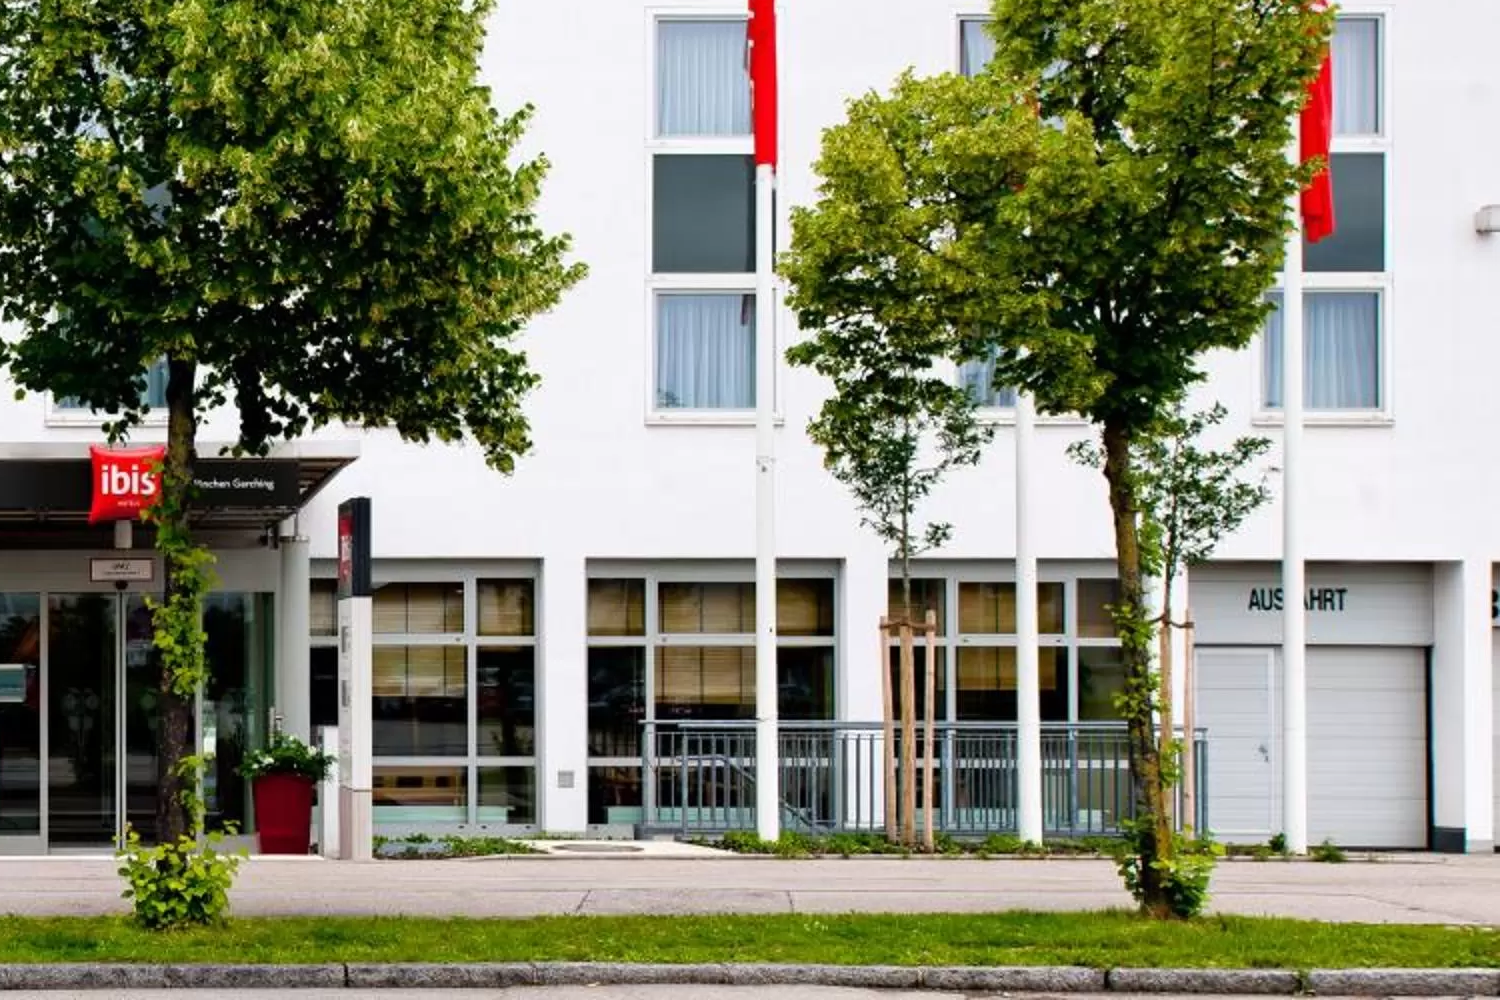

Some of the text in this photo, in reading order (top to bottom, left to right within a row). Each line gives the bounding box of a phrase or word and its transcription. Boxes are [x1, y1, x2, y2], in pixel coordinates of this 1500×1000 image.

[101, 464, 156, 495] ibis
[232, 477, 275, 491] Garching
[1248, 587, 1348, 611] AUSHRT
